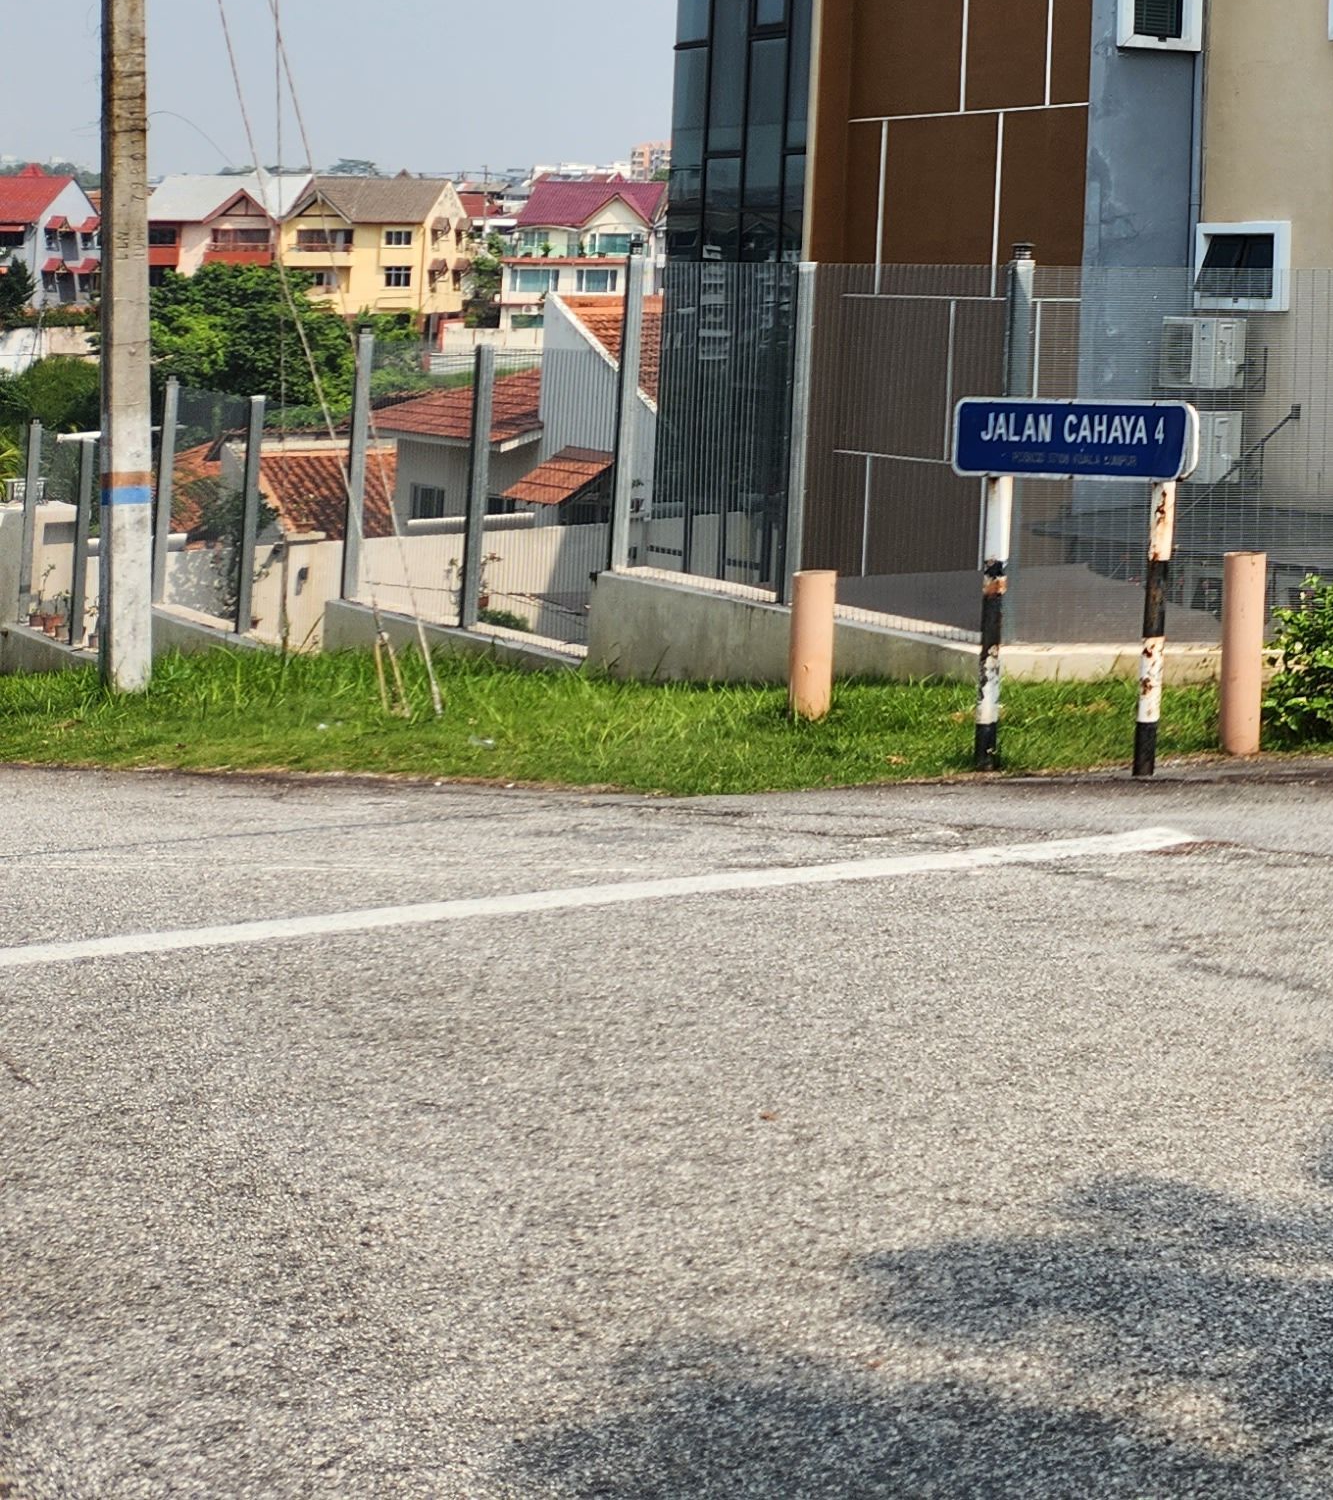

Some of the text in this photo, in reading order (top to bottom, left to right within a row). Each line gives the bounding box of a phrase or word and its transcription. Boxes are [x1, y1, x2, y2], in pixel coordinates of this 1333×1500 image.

[980, 412, 1165, 445] JALAN CAHAYA 4
